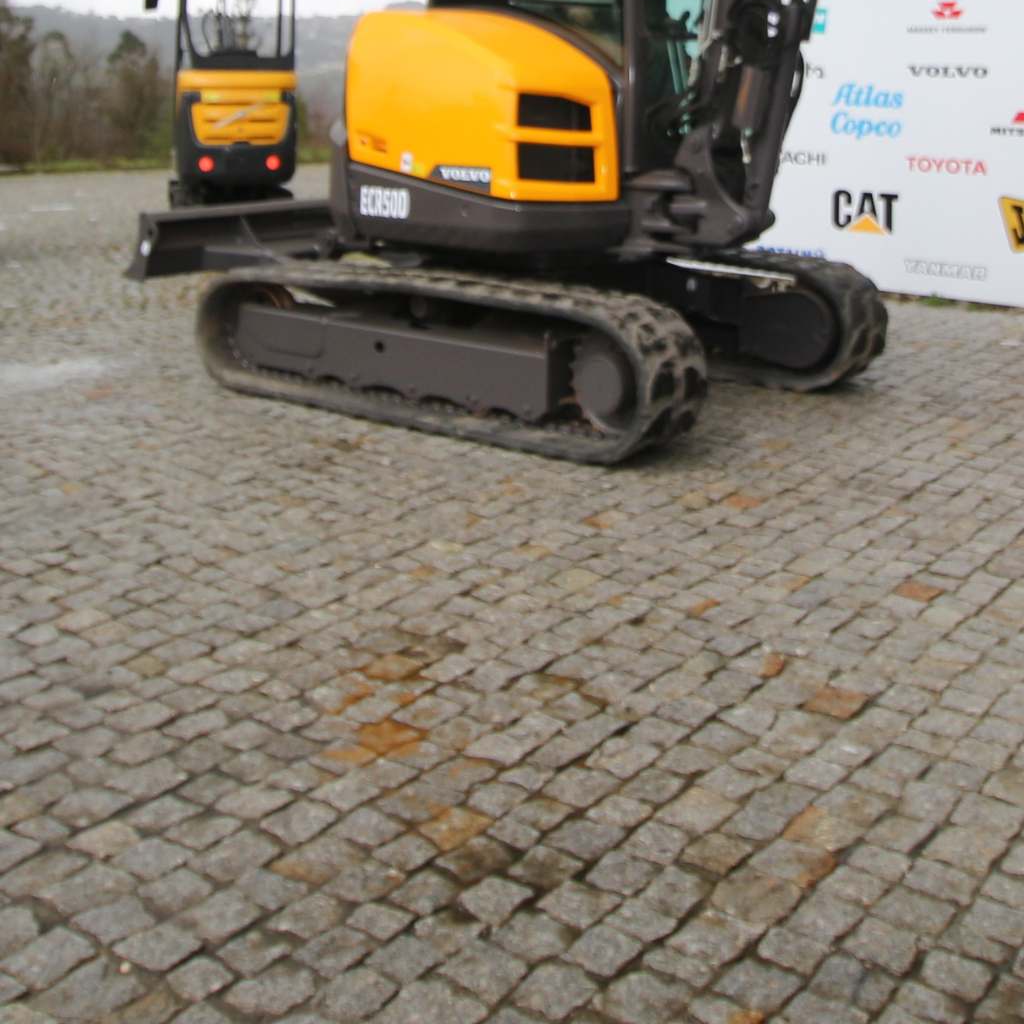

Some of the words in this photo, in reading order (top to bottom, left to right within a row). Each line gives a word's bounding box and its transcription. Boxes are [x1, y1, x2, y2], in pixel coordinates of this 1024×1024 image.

[907, 65, 988, 79] VOLVO
[830, 82, 904, 110] Atlas
[829, 111, 902, 140] Copco
[439, 166, 491, 183] VOLVO
[906, 156, 988, 176] TOYOTA
[832, 189, 899, 235] CAT
[904, 259, 987, 281] YANMAR
